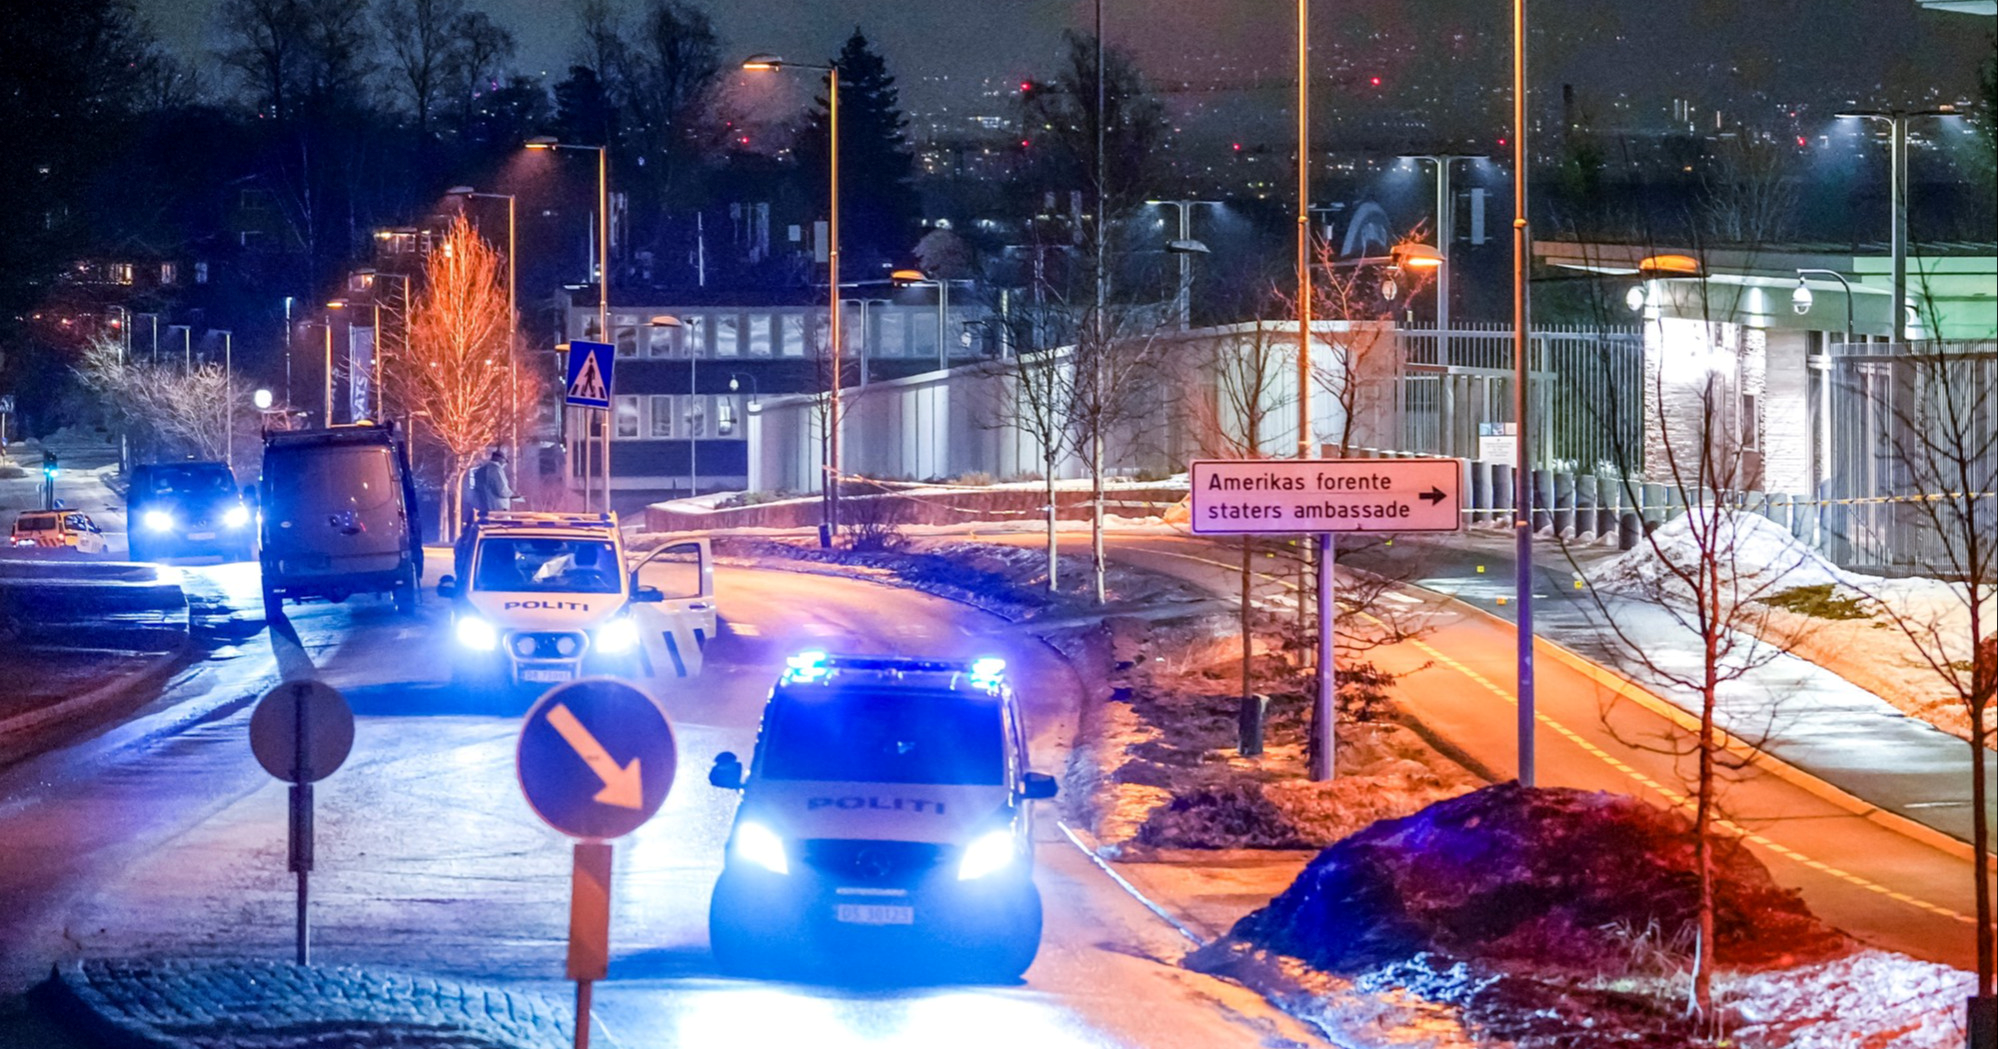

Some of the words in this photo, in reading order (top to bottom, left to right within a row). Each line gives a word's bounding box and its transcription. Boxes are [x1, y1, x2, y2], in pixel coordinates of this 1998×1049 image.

[352, 375, 368, 421] SATS
[1209, 473, 1305, 490] Amerikas
[1317, 472, 1391, 490] forente
[1208, 503, 1282, 519] staters
[1294, 500, 1410, 518] ambassade
[505, 601, 588, 611] POLITI
[807, 797, 945, 814] POLITI
